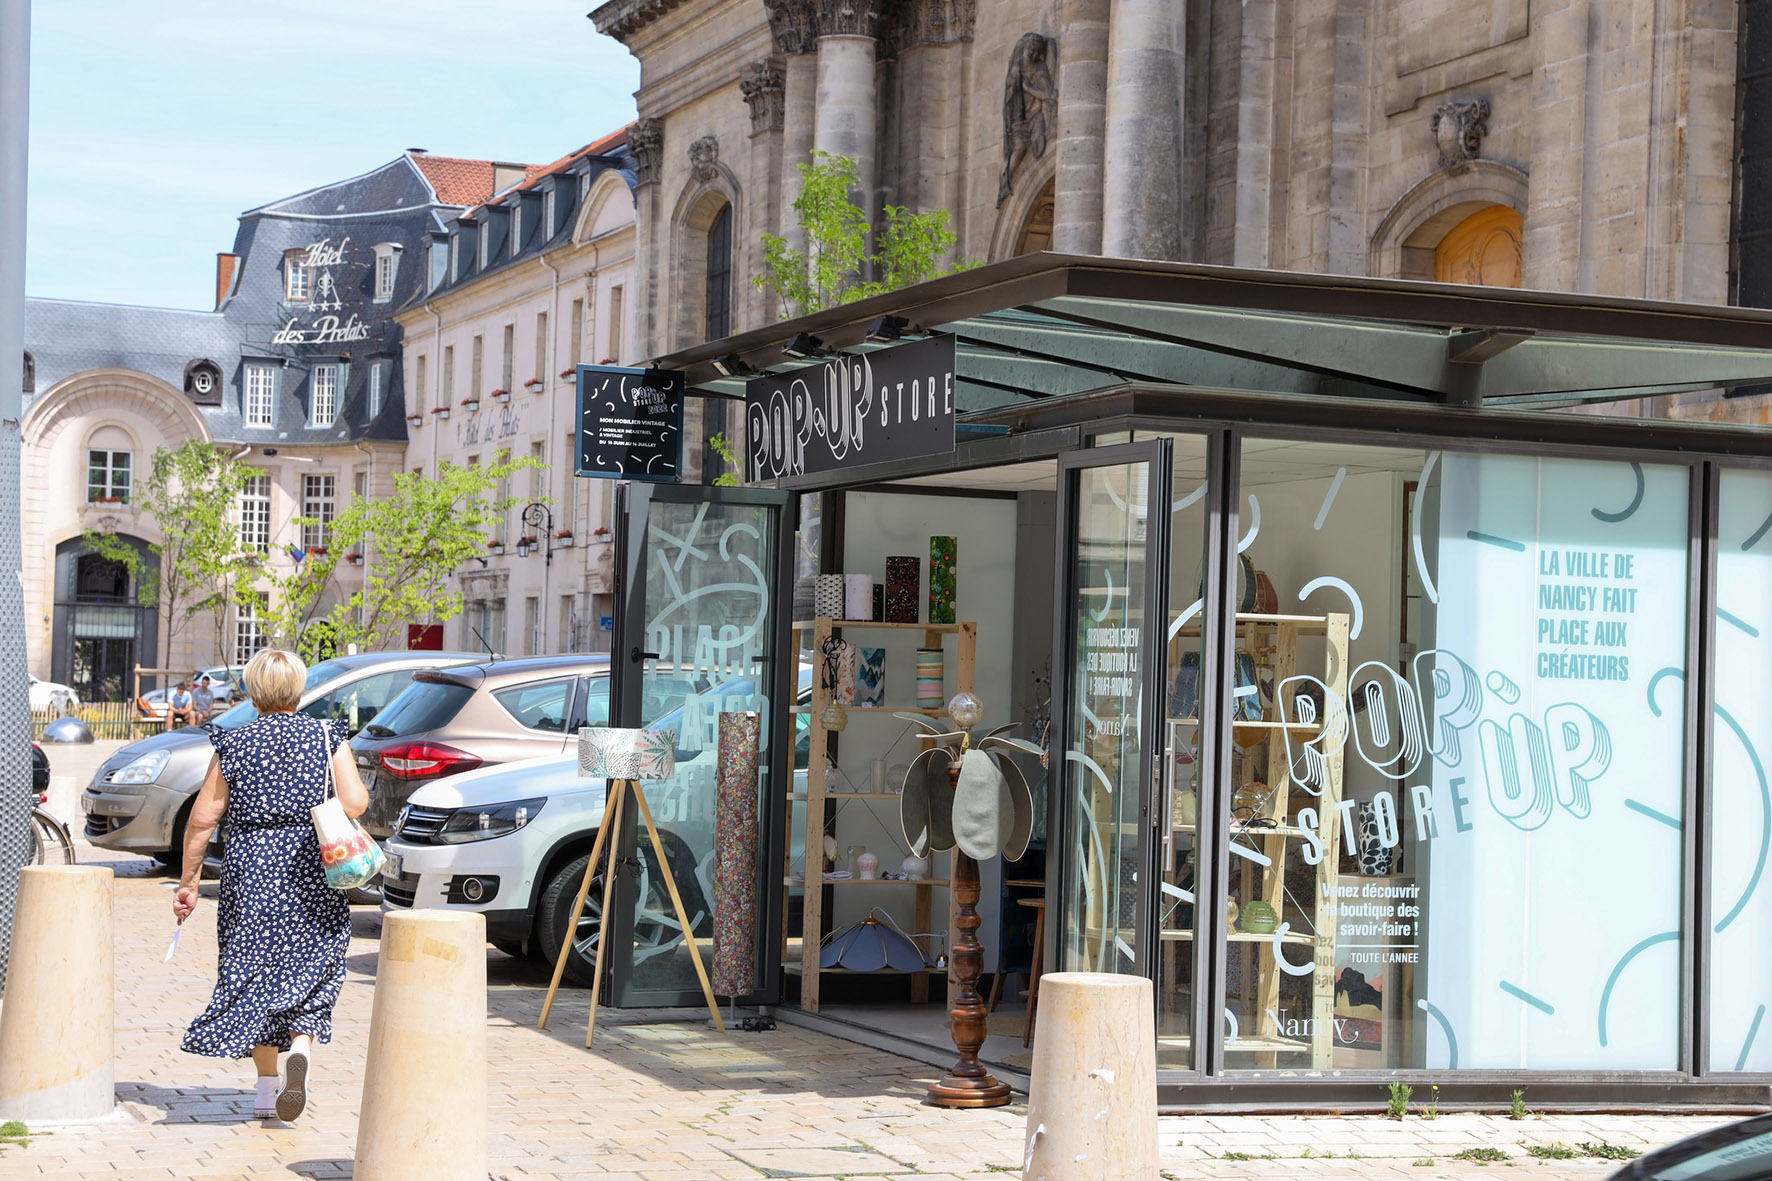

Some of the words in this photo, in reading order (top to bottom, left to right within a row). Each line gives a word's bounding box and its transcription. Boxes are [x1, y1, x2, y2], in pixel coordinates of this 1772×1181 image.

[300, 237, 350, 267] Hôtel
[273, 317, 305, 344] des
[881, 372, 952, 427] STORE
[1540, 550, 1560, 576] LA
[1566, 551, 1609, 578] VILLE
[1614, 553, 1634, 579] DE
[1539, 584, 1597, 611] NANCY
[1603, 587, 1638, 613] FAIT
[1538, 618, 1589, 645] PLACE
[1594, 621, 1627, 647] AUX
[1537, 648, 1629, 681] CRÉATEURS
[1297, 776, 1473, 865] STORE
[1362, 883, 1420, 898] découvrir
[1340, 902, 1394, 920] boutique
[1397, 902, 1420, 917] des
[1340, 922, 1411, 936] savoir-faire
[1351, 953, 1379, 963] TOUTE
[1382, 952, 1419, 963] L'ANNEE
